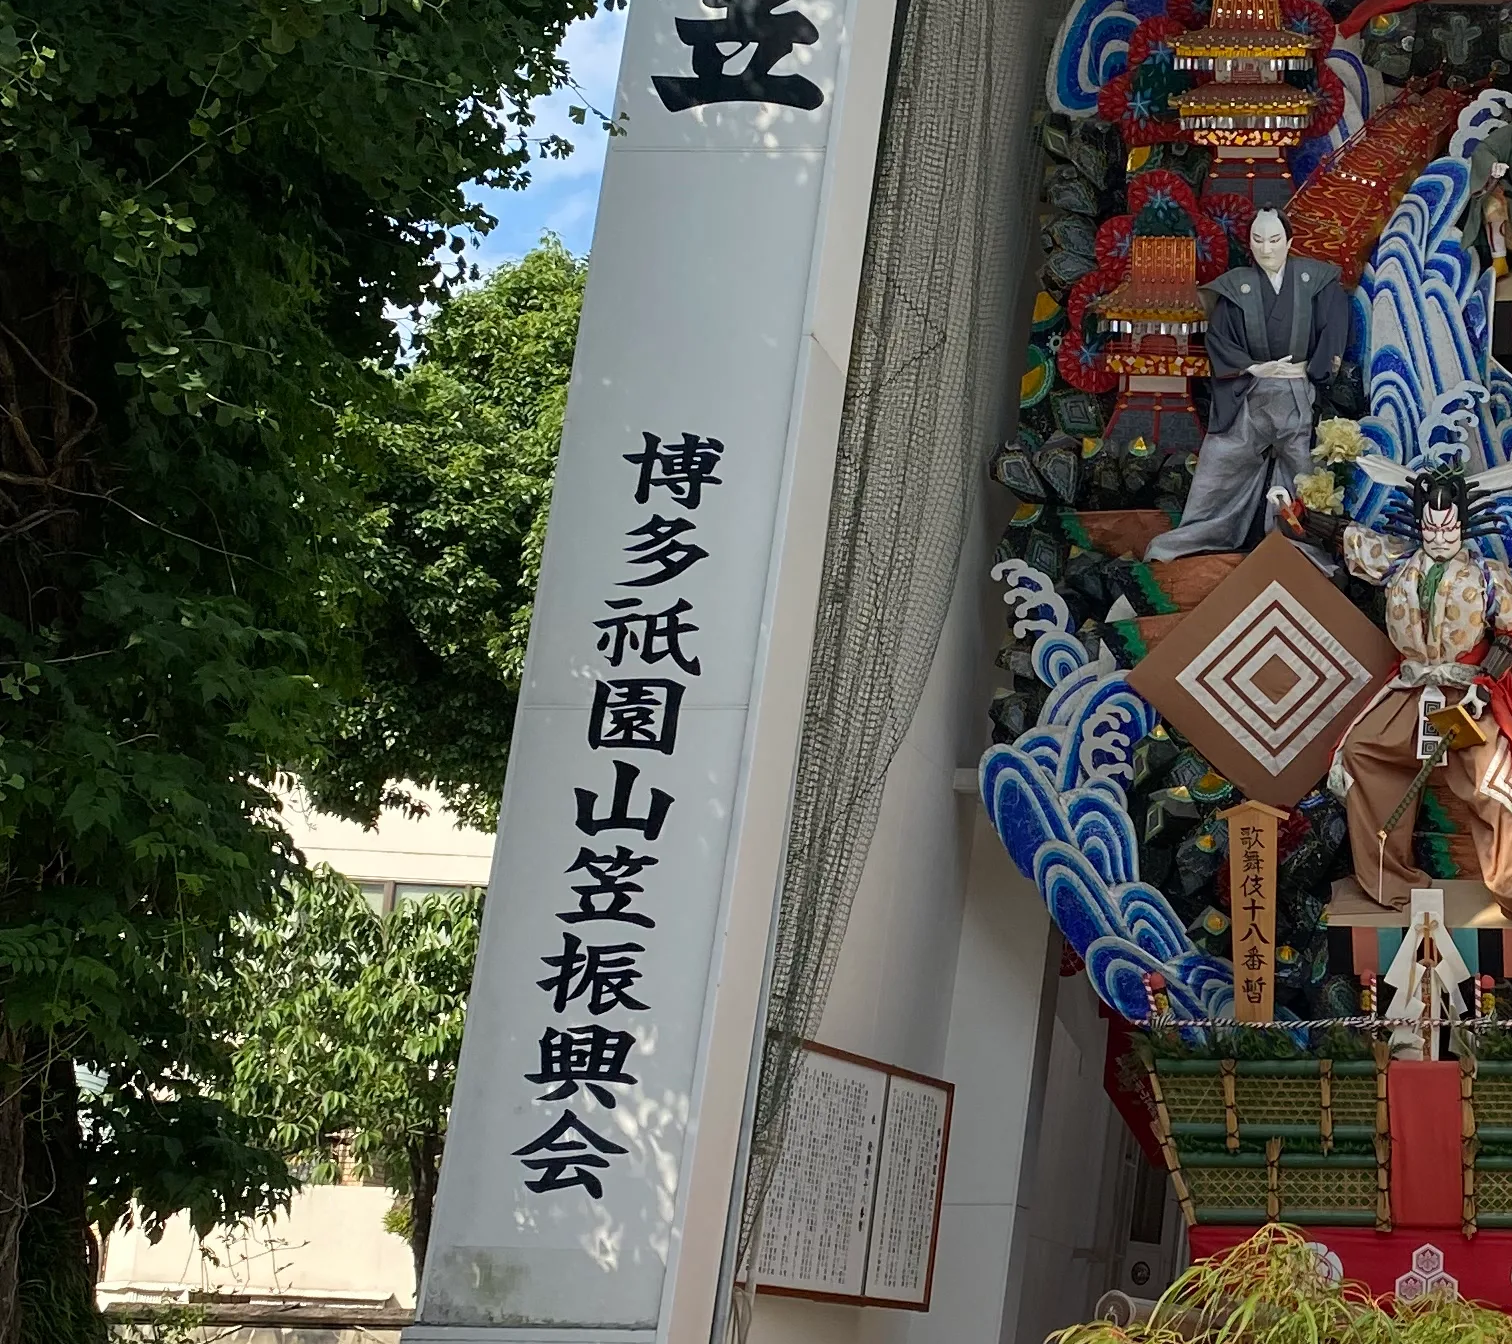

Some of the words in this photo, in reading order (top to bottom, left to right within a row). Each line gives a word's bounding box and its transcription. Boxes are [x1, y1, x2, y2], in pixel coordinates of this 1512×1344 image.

[511, 430, 724, 1200] 博多祇園山笠振興会
